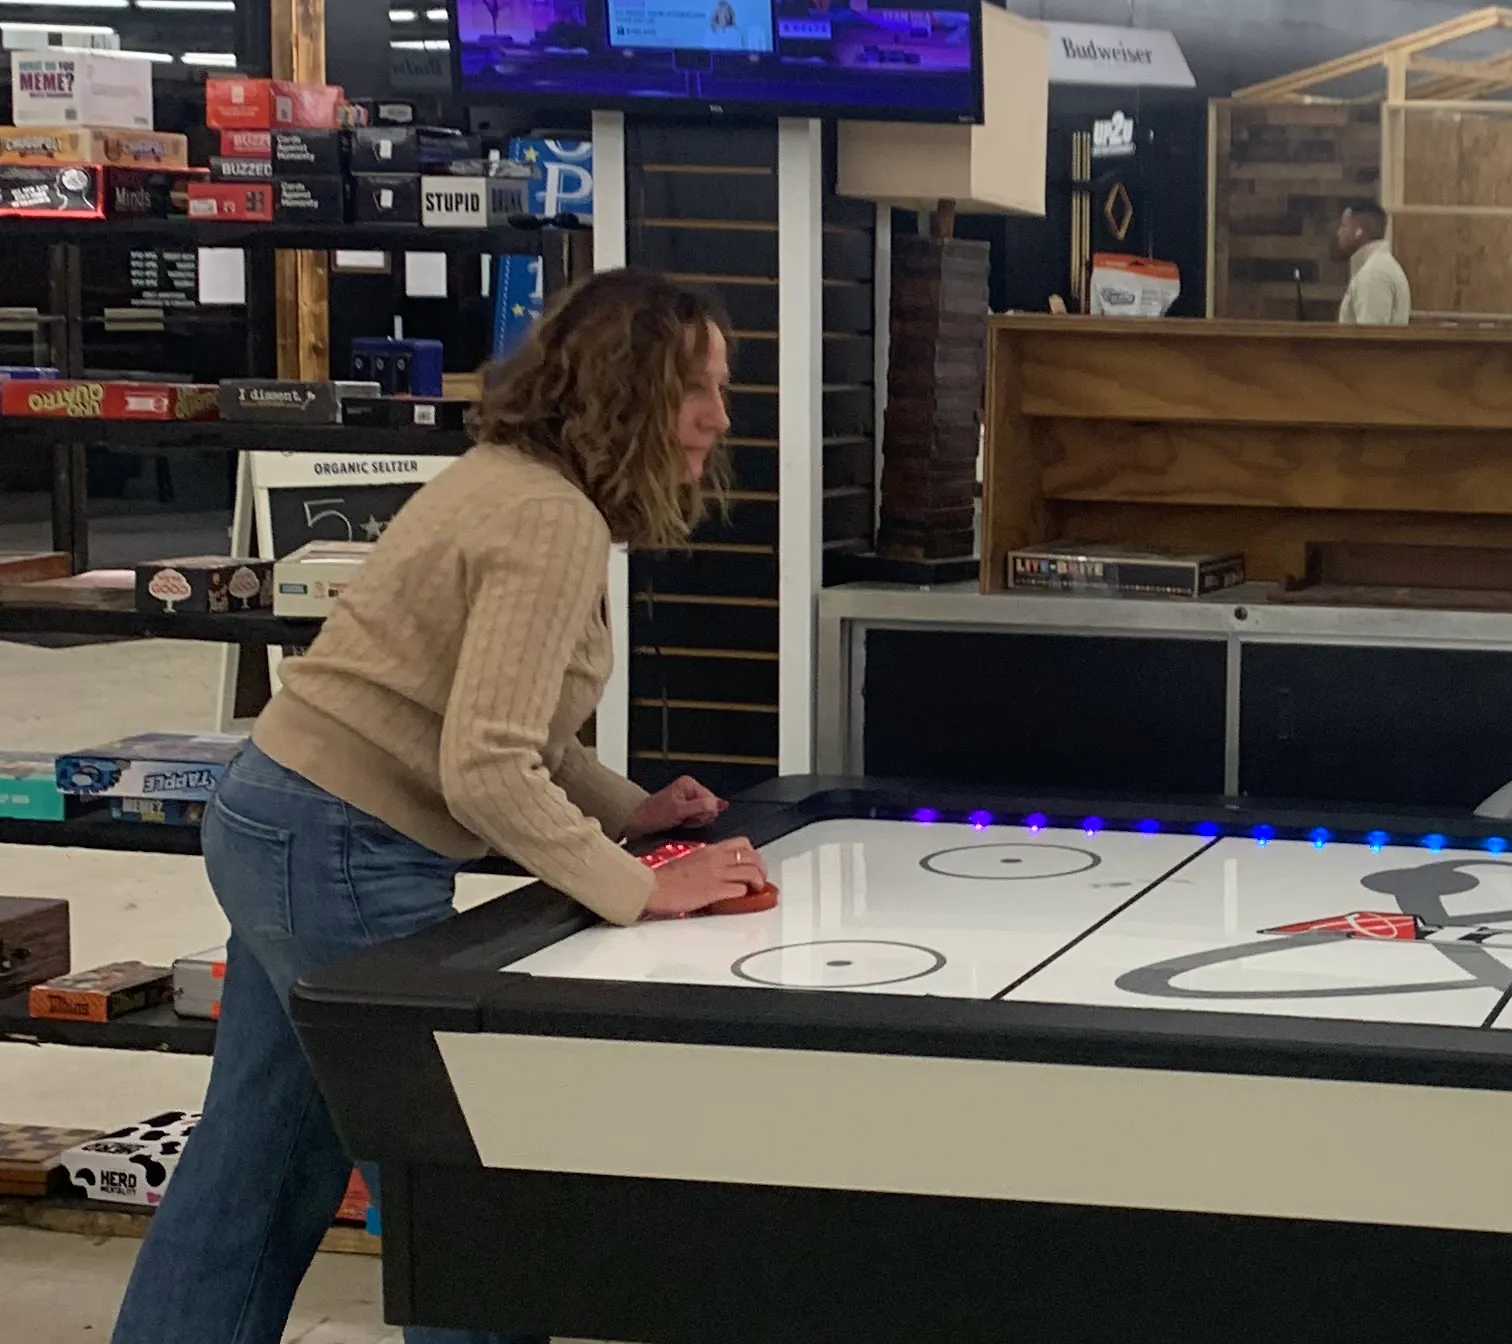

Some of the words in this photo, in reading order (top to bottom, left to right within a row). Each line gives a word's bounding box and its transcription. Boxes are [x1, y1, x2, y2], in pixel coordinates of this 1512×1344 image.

[1061, 37, 1152, 64] Budweiser
[19, 72, 75, 92] MEME?
[221, 162, 272, 177] BUZZED
[425, 192, 480, 213] STUPID
[28, 383, 104, 412] QUATRO
[314, 461, 368, 475] ORGANIC
[372, 459, 418, 473] SELTZER
[143, 770, 212, 794] TAPPLE
[100, 1170, 137, 1188] HERD
